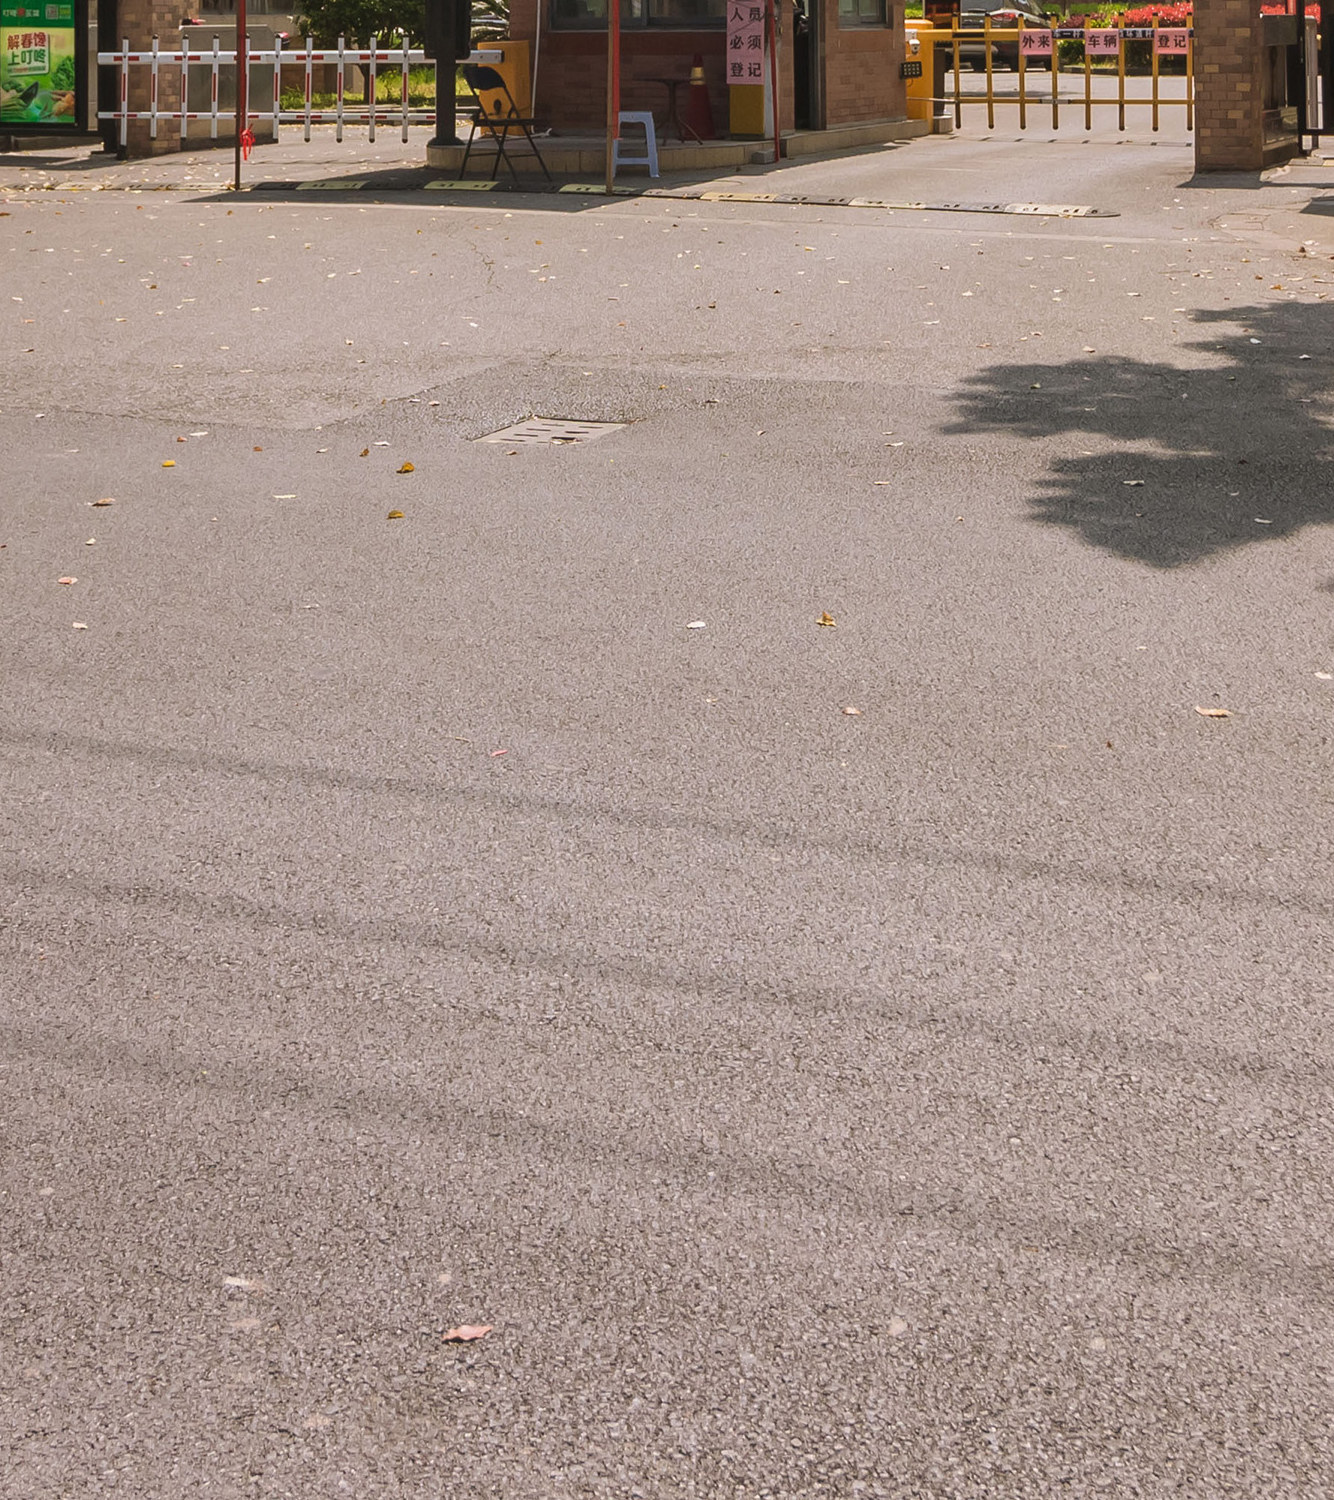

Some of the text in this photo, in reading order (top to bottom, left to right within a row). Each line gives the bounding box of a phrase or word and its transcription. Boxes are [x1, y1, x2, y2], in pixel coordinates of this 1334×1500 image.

[730, 7, 761, 22] 人员
[7, 31, 46, 51] 解春馋
[730, 34, 761, 50] 必须
[1022, 34, 1050, 48] 外来
[1088, 34, 1117, 48] 车辆
[1157, 34, 1186, 48] 登记
[7, 48, 46, 66] 上叮咚
[730, 62, 762, 77] 登记
